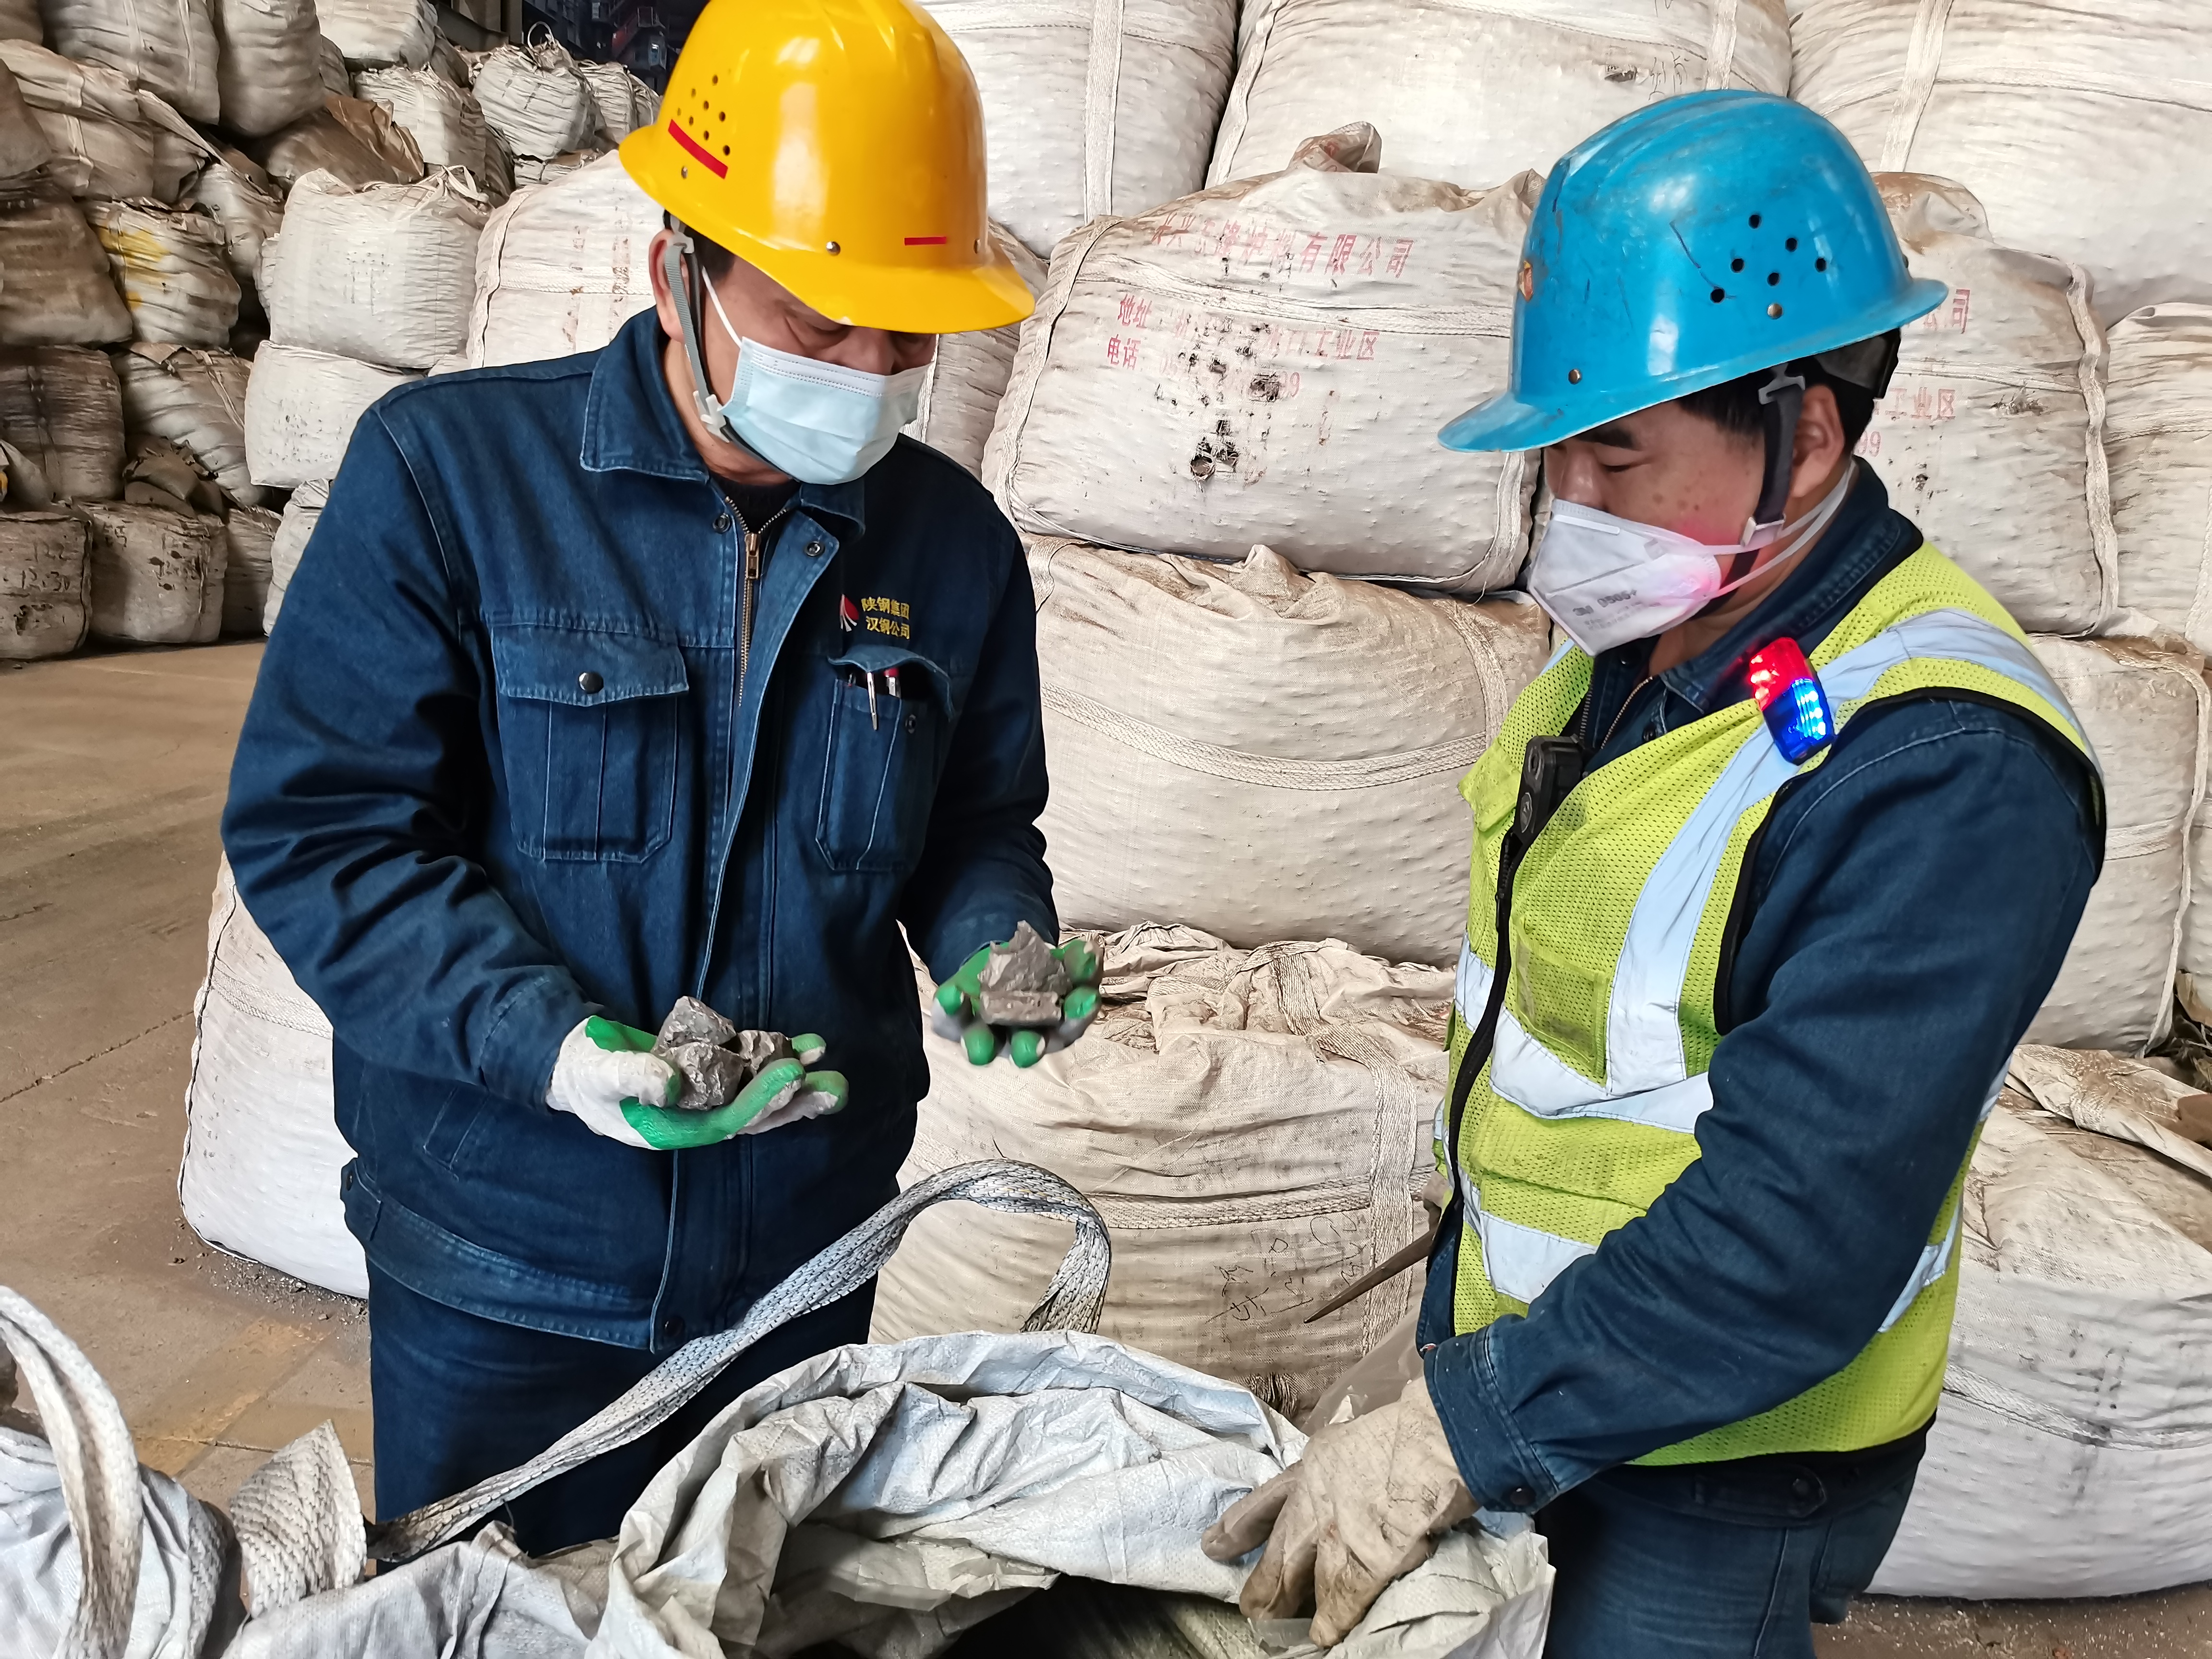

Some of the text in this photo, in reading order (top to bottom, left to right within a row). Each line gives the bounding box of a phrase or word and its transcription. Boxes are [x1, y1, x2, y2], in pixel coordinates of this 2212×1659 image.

[1873, 386, 1956, 420] 工业区
[861, 597, 910, 620] 陕钢集团
[866, 616, 910, 639] 汉钢公司
